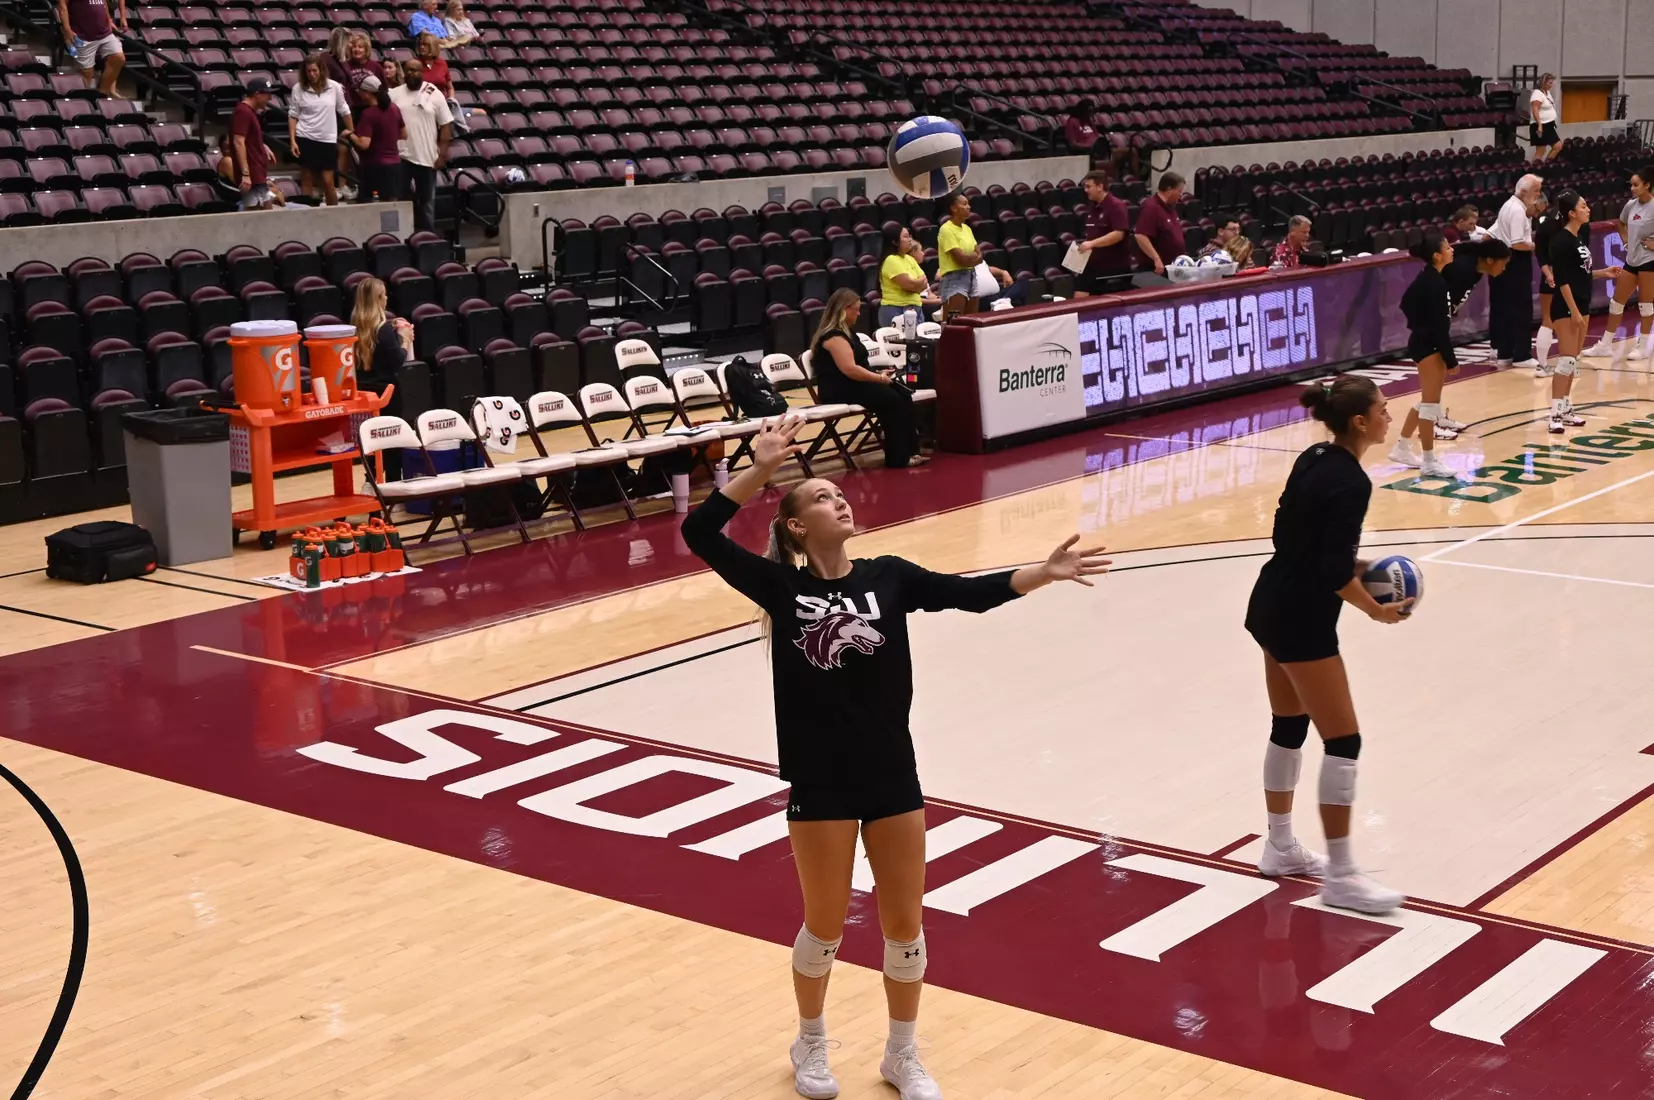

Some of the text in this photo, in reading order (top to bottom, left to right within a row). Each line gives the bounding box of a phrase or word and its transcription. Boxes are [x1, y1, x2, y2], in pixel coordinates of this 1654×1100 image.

[275, 347, 293, 371] G
[340, 347, 353, 367] G
[998, 363, 1065, 393] Banterra
[1040, 385, 1067, 398] CENTER
[305, 405, 345, 420] GATORADE
[296, 562, 304, 577] G
[795, 591, 881, 620] SIU
